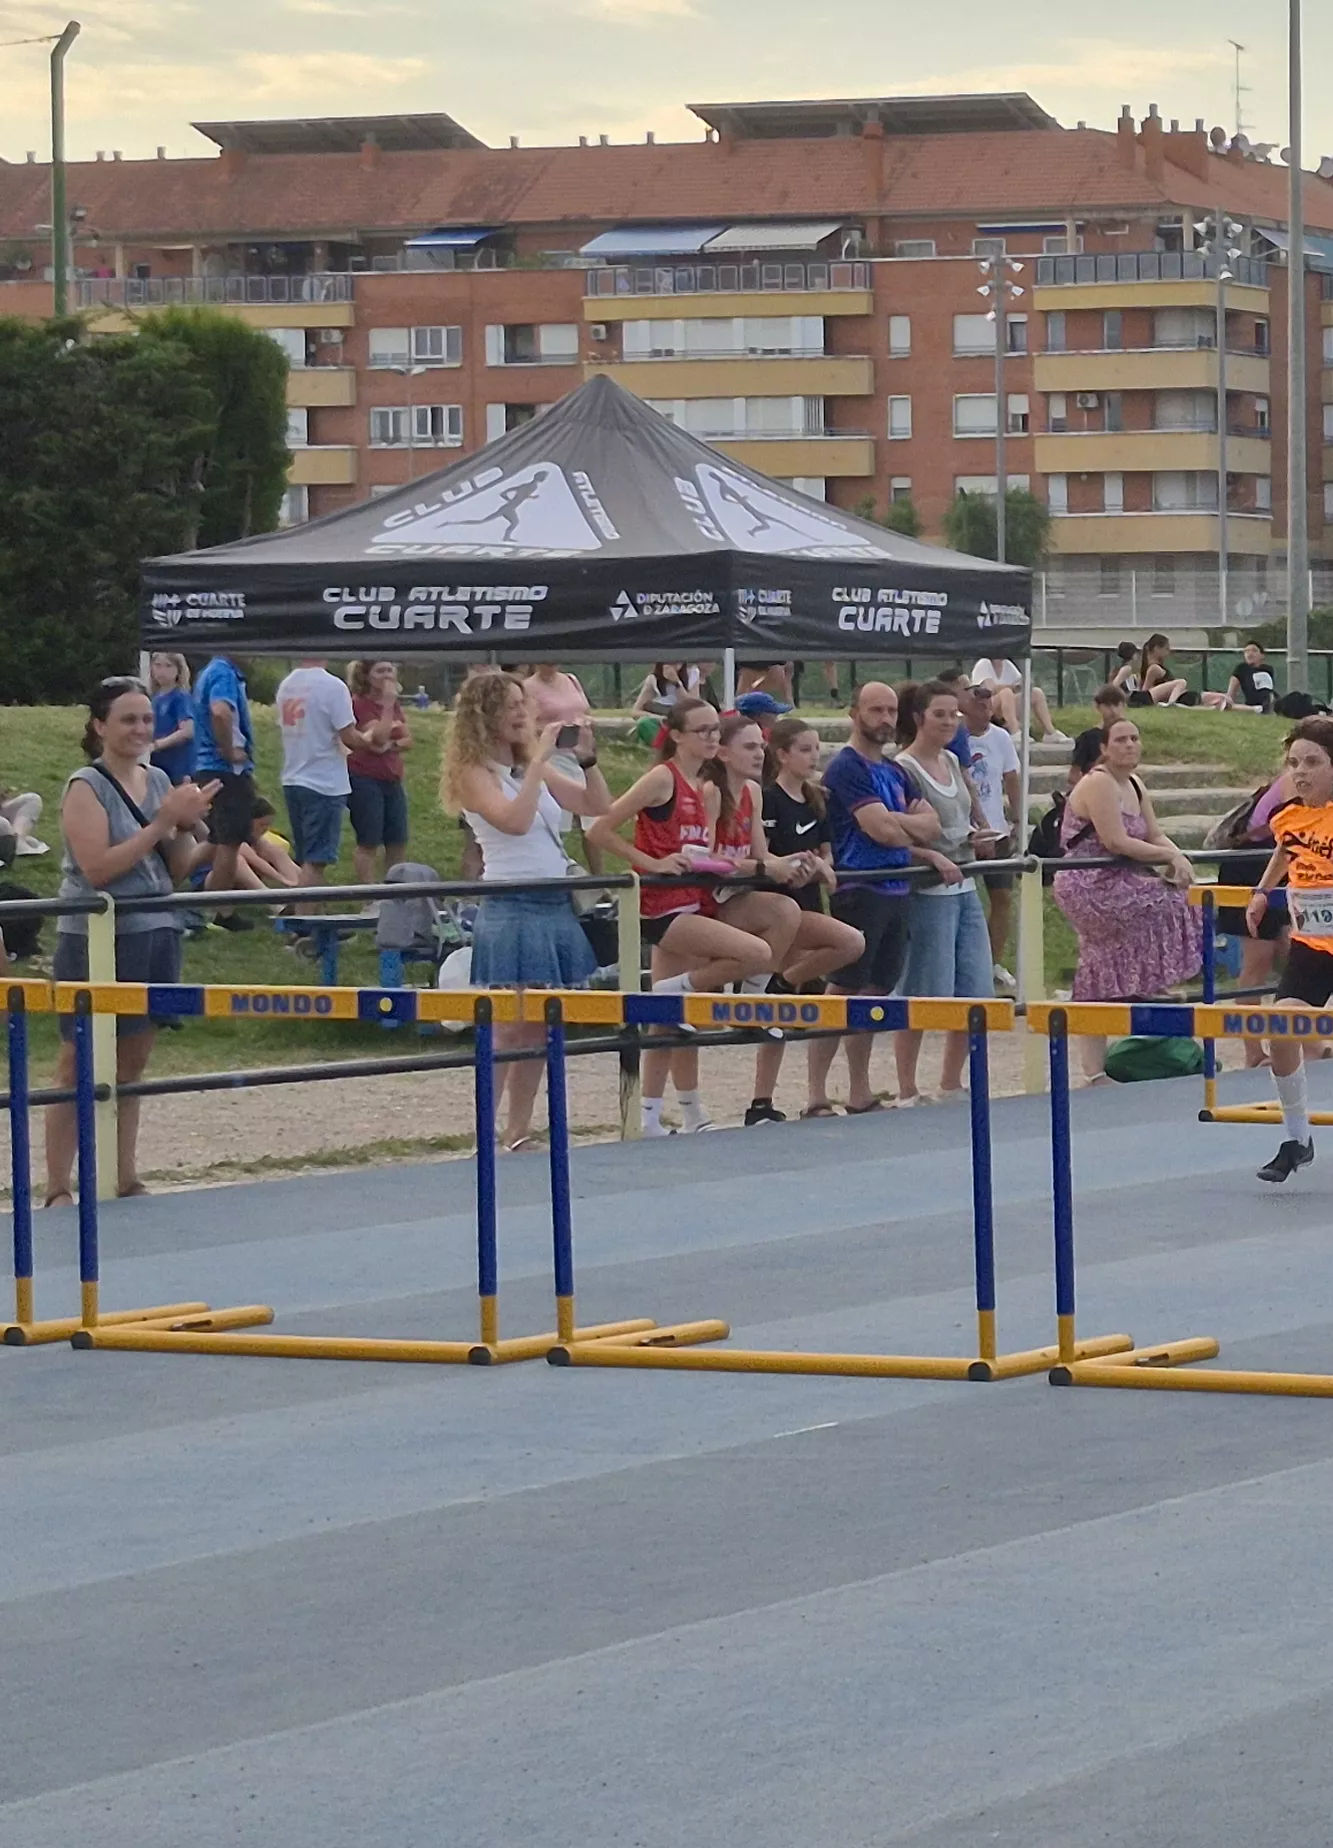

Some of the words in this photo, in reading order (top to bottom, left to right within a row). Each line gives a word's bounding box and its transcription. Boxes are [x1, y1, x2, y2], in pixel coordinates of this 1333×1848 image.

[186, 593, 246, 607] CUARTE
[323, 587, 396, 602] CLUB
[408, 586, 548, 601] ATLETISMO
[636, 590, 713, 604] DIPUTACIÓN
[832, 587, 871, 602] CLUB
[877, 588, 948, 607] ATLETISMO
[653, 603, 720, 615] ZARAGOZA
[333, 605, 534, 634] CUARTE
[838, 606, 941, 637] CUARTE
[230, 993, 332, 1014] MONDO
[712, 1002, 820, 1023] MONDO
